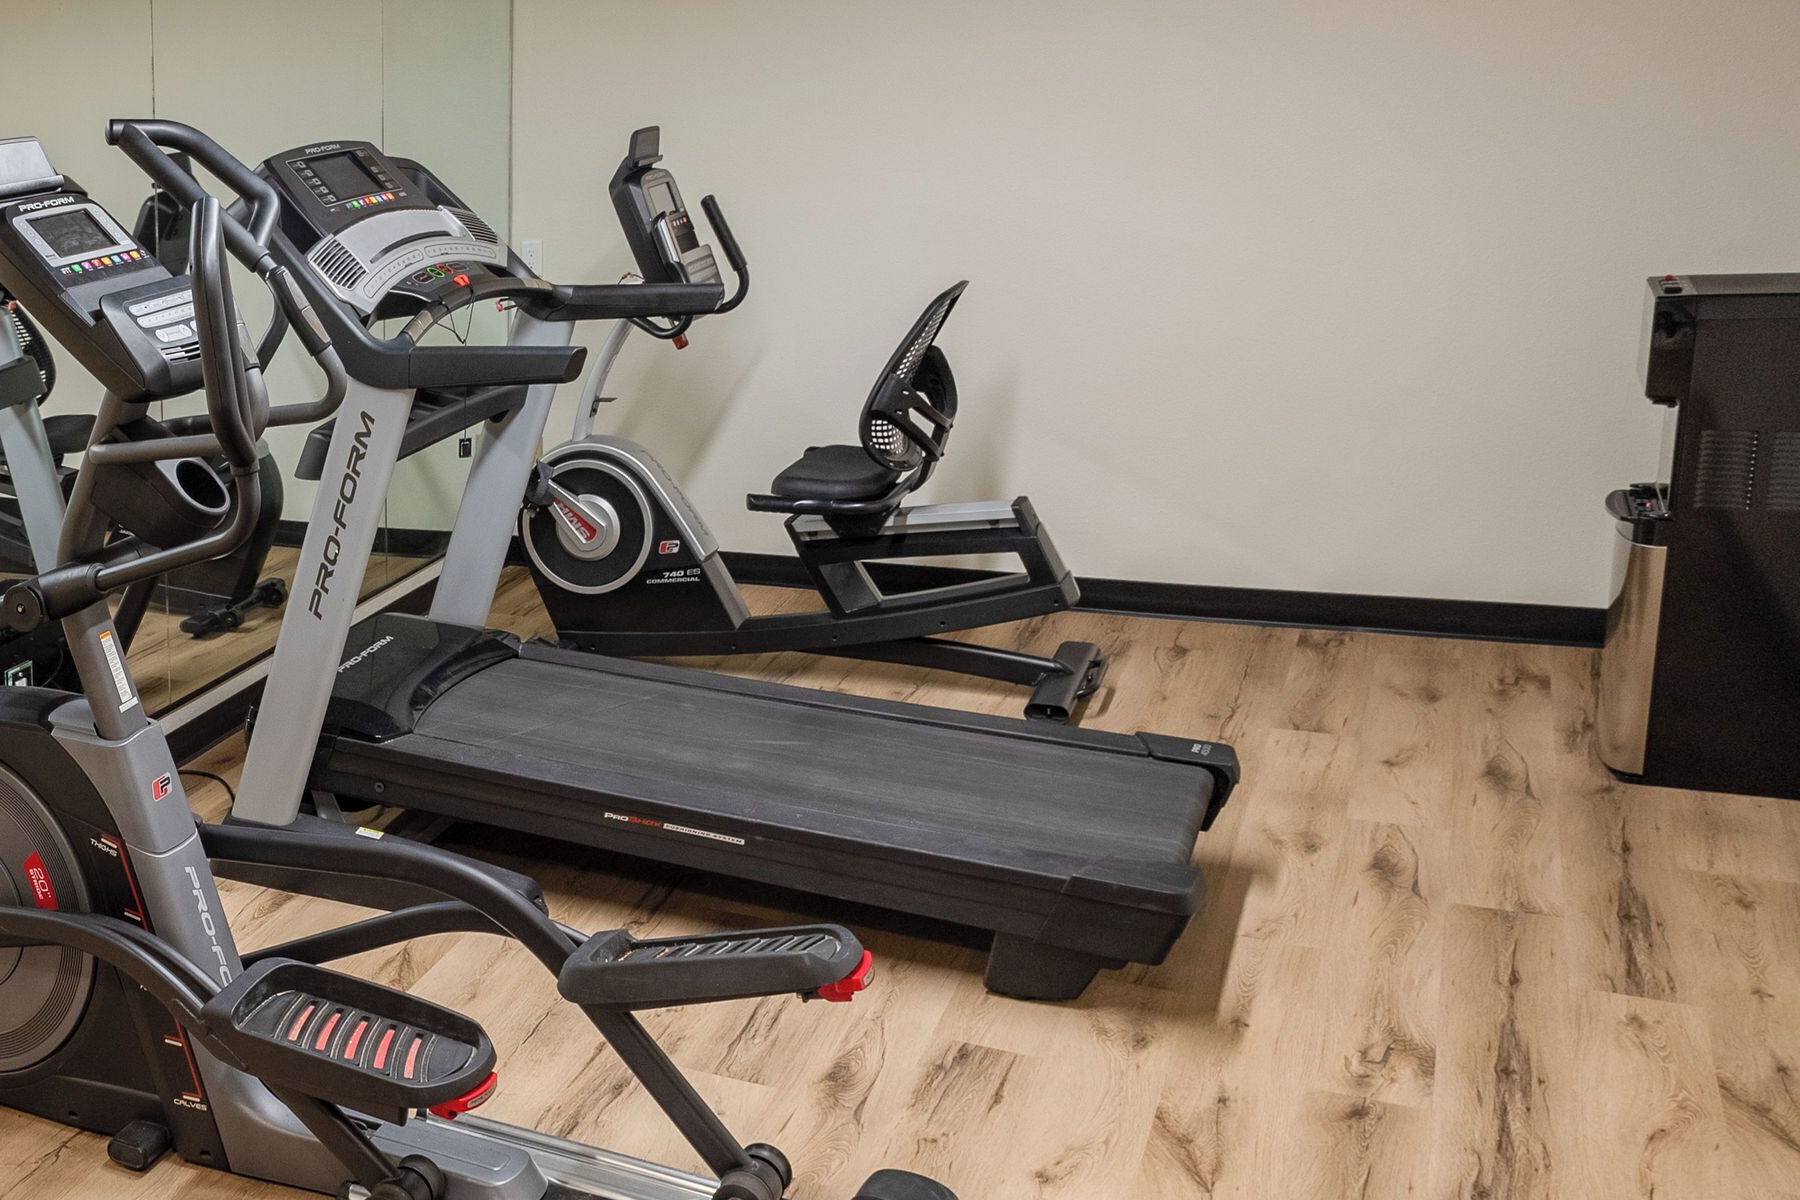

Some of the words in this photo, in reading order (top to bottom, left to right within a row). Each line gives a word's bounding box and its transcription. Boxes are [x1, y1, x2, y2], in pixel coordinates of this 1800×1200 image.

[304, 143, 341, 155] PRO-FORM
[18, 195, 75, 212] PRO-FORM
[308, 410, 375, 621] PRO-FORM
[646, 577, 701, 585] COMMERCIAL
[662, 570, 685, 579] 740
[337, 635, 394, 673] PRO-FORM
[90, 838, 118, 857] THIGHS
[184, 866, 233, 988] PRO-FO
[173, 1098, 207, 1111] CALVES
